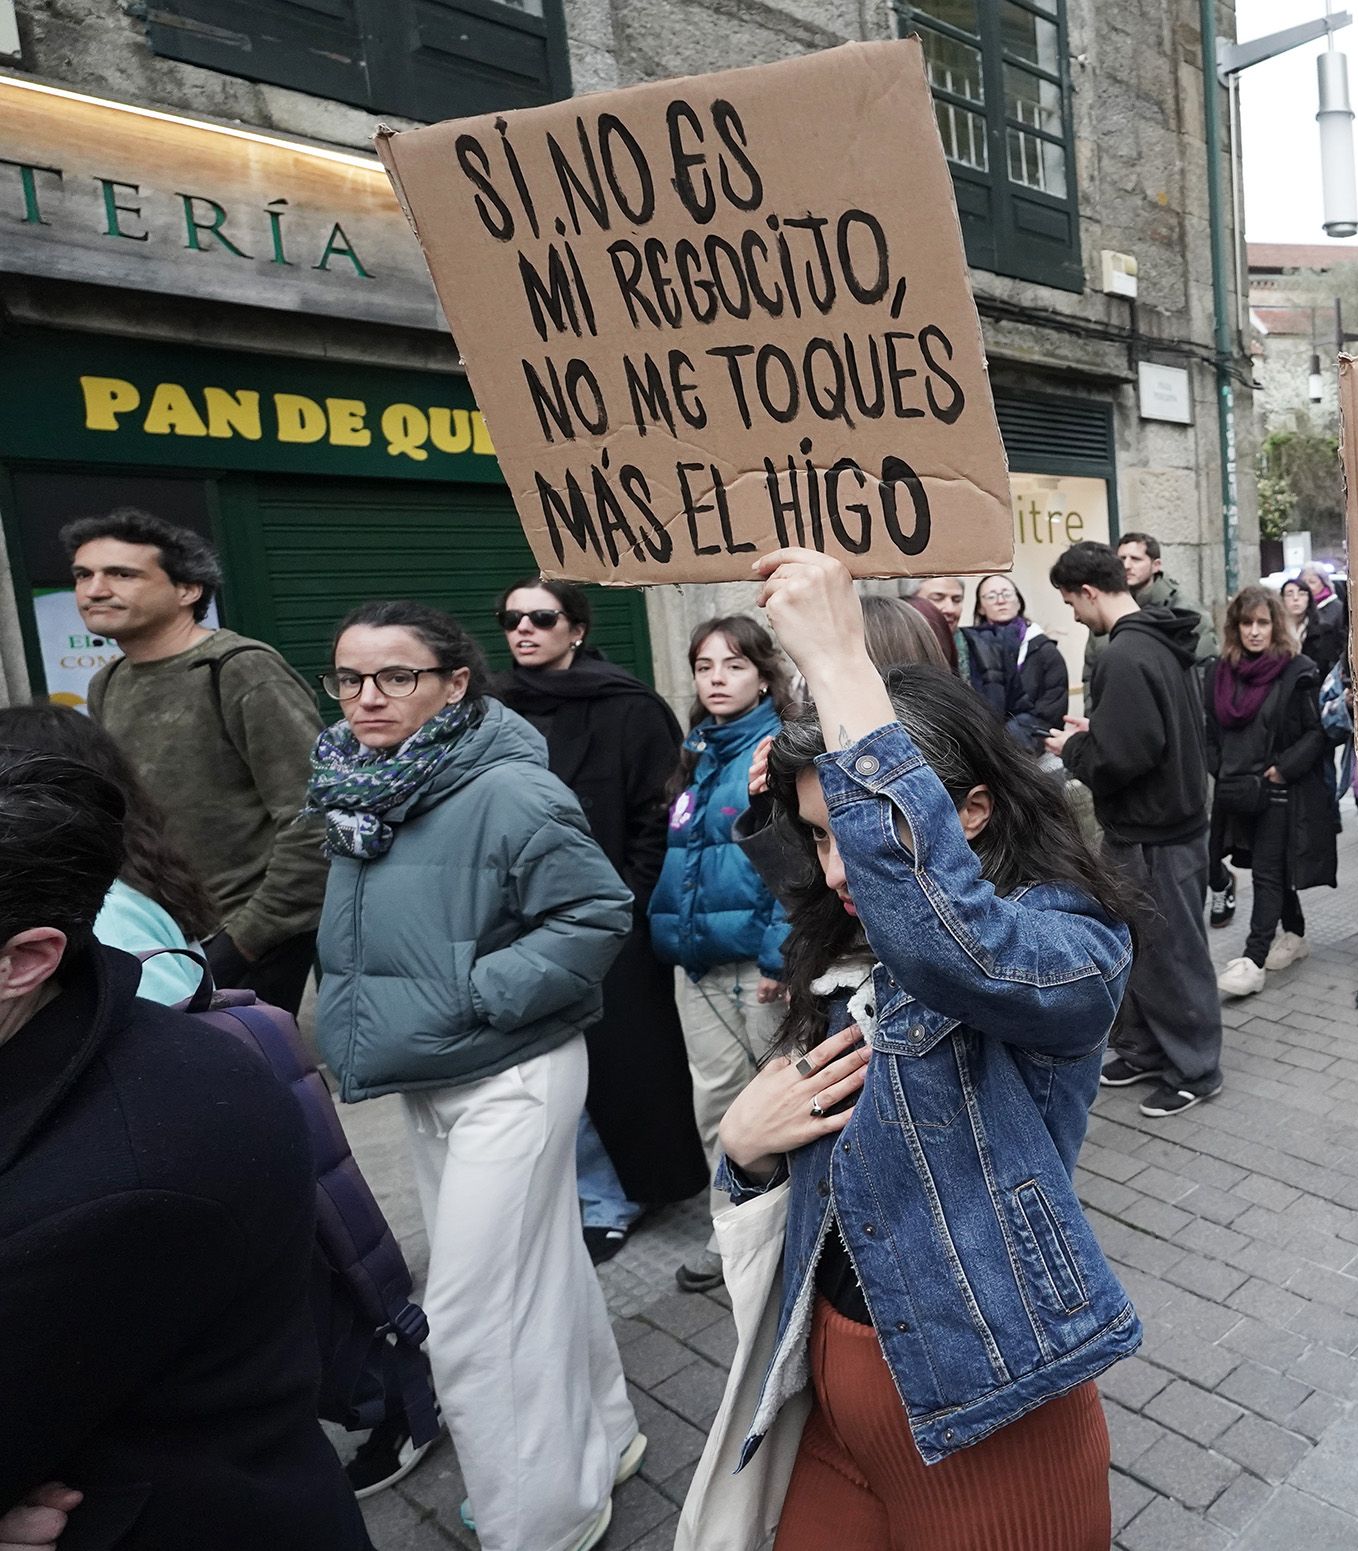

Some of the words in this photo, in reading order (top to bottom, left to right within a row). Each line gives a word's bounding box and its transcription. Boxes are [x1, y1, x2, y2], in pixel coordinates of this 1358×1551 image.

[0, 158, 376, 279] TERÍA
[546, 112, 655, 236] NO
[666, 98, 764, 225] ES
[516, 217, 599, 342] MI
[80, 376, 263, 441] PAN
[273, 393, 371, 447] DE
[521, 355, 610, 443] NO
[623, 349, 707, 440] ME
[705, 324, 966, 430] TOQUES
[534, 447, 673, 568] MÁS
[676, 461, 757, 556] EL
[763, 437, 931, 556] HIGO
